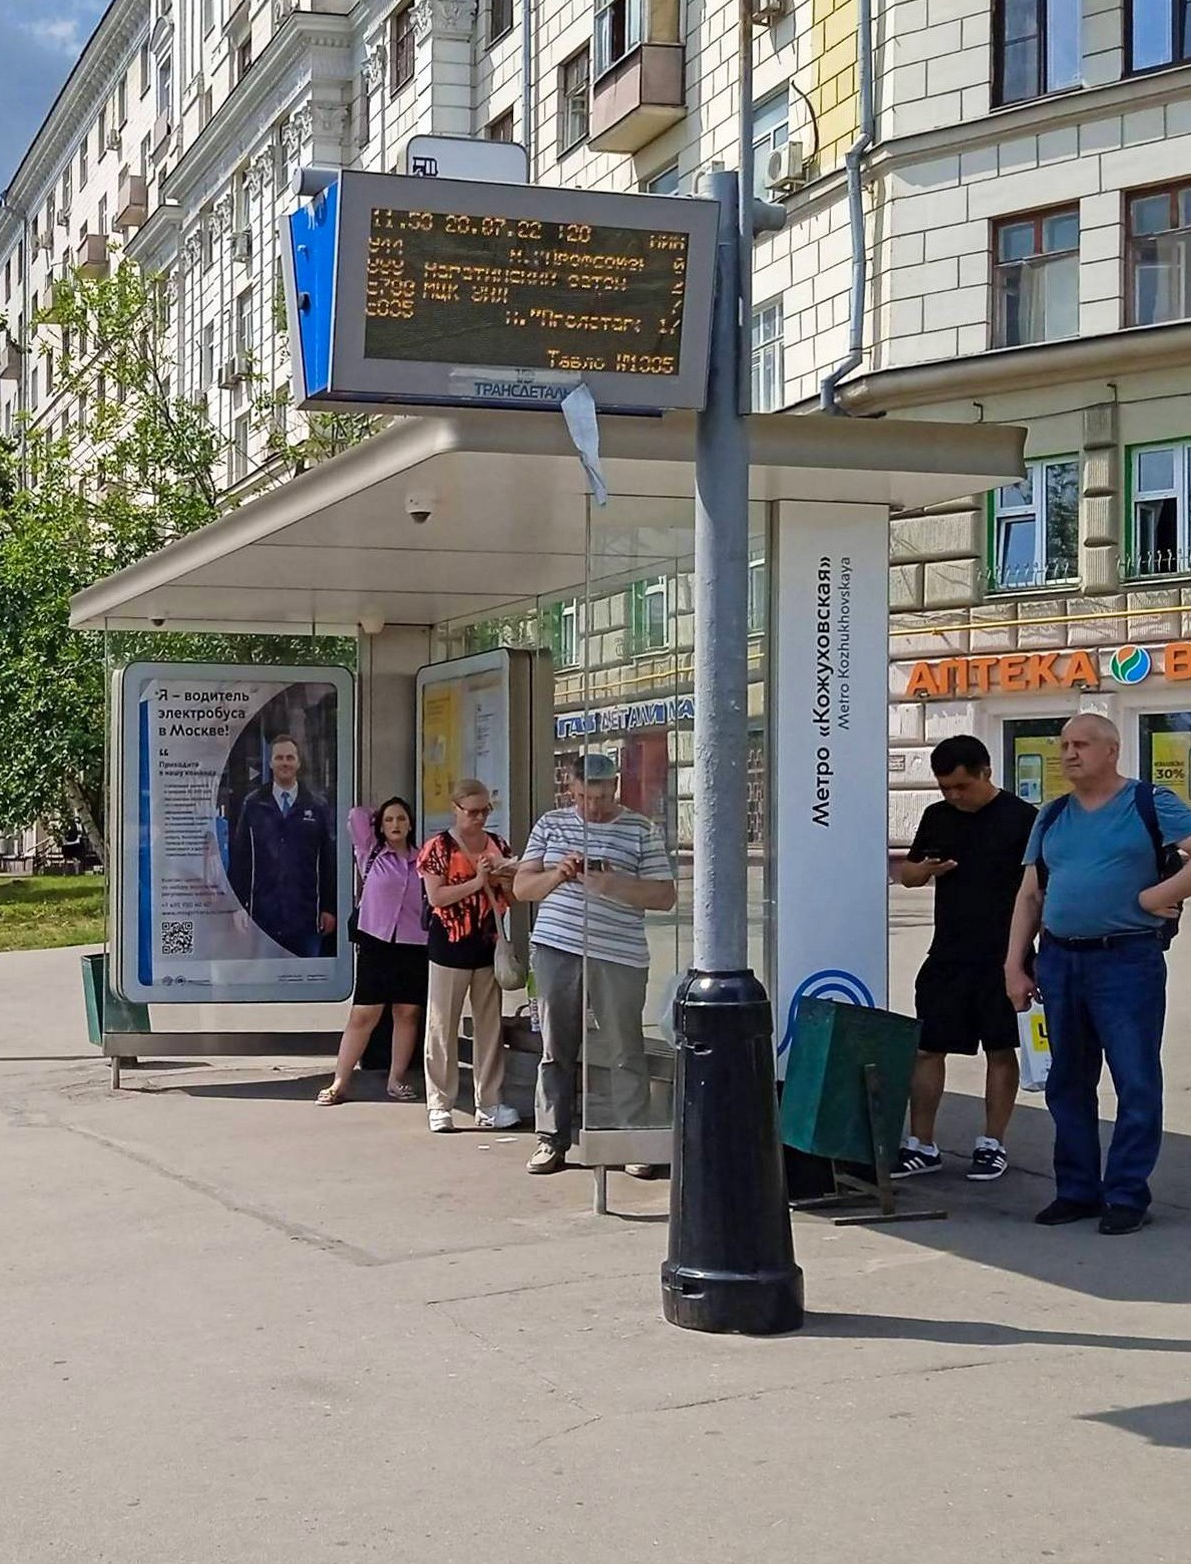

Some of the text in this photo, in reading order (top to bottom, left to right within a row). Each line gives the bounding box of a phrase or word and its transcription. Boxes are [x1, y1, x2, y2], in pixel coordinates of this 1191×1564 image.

[837, 557, 853, 730] Metro Kozhukhovskaya
[905, 651, 1099, 696] АПТЕКА
[184, 692, 249, 703] водитель
[811, 556, 834, 827] Метро «Кожуховская»
[158, 706, 246, 721] электробуса
[159, 724, 229, 736] в Москве!
